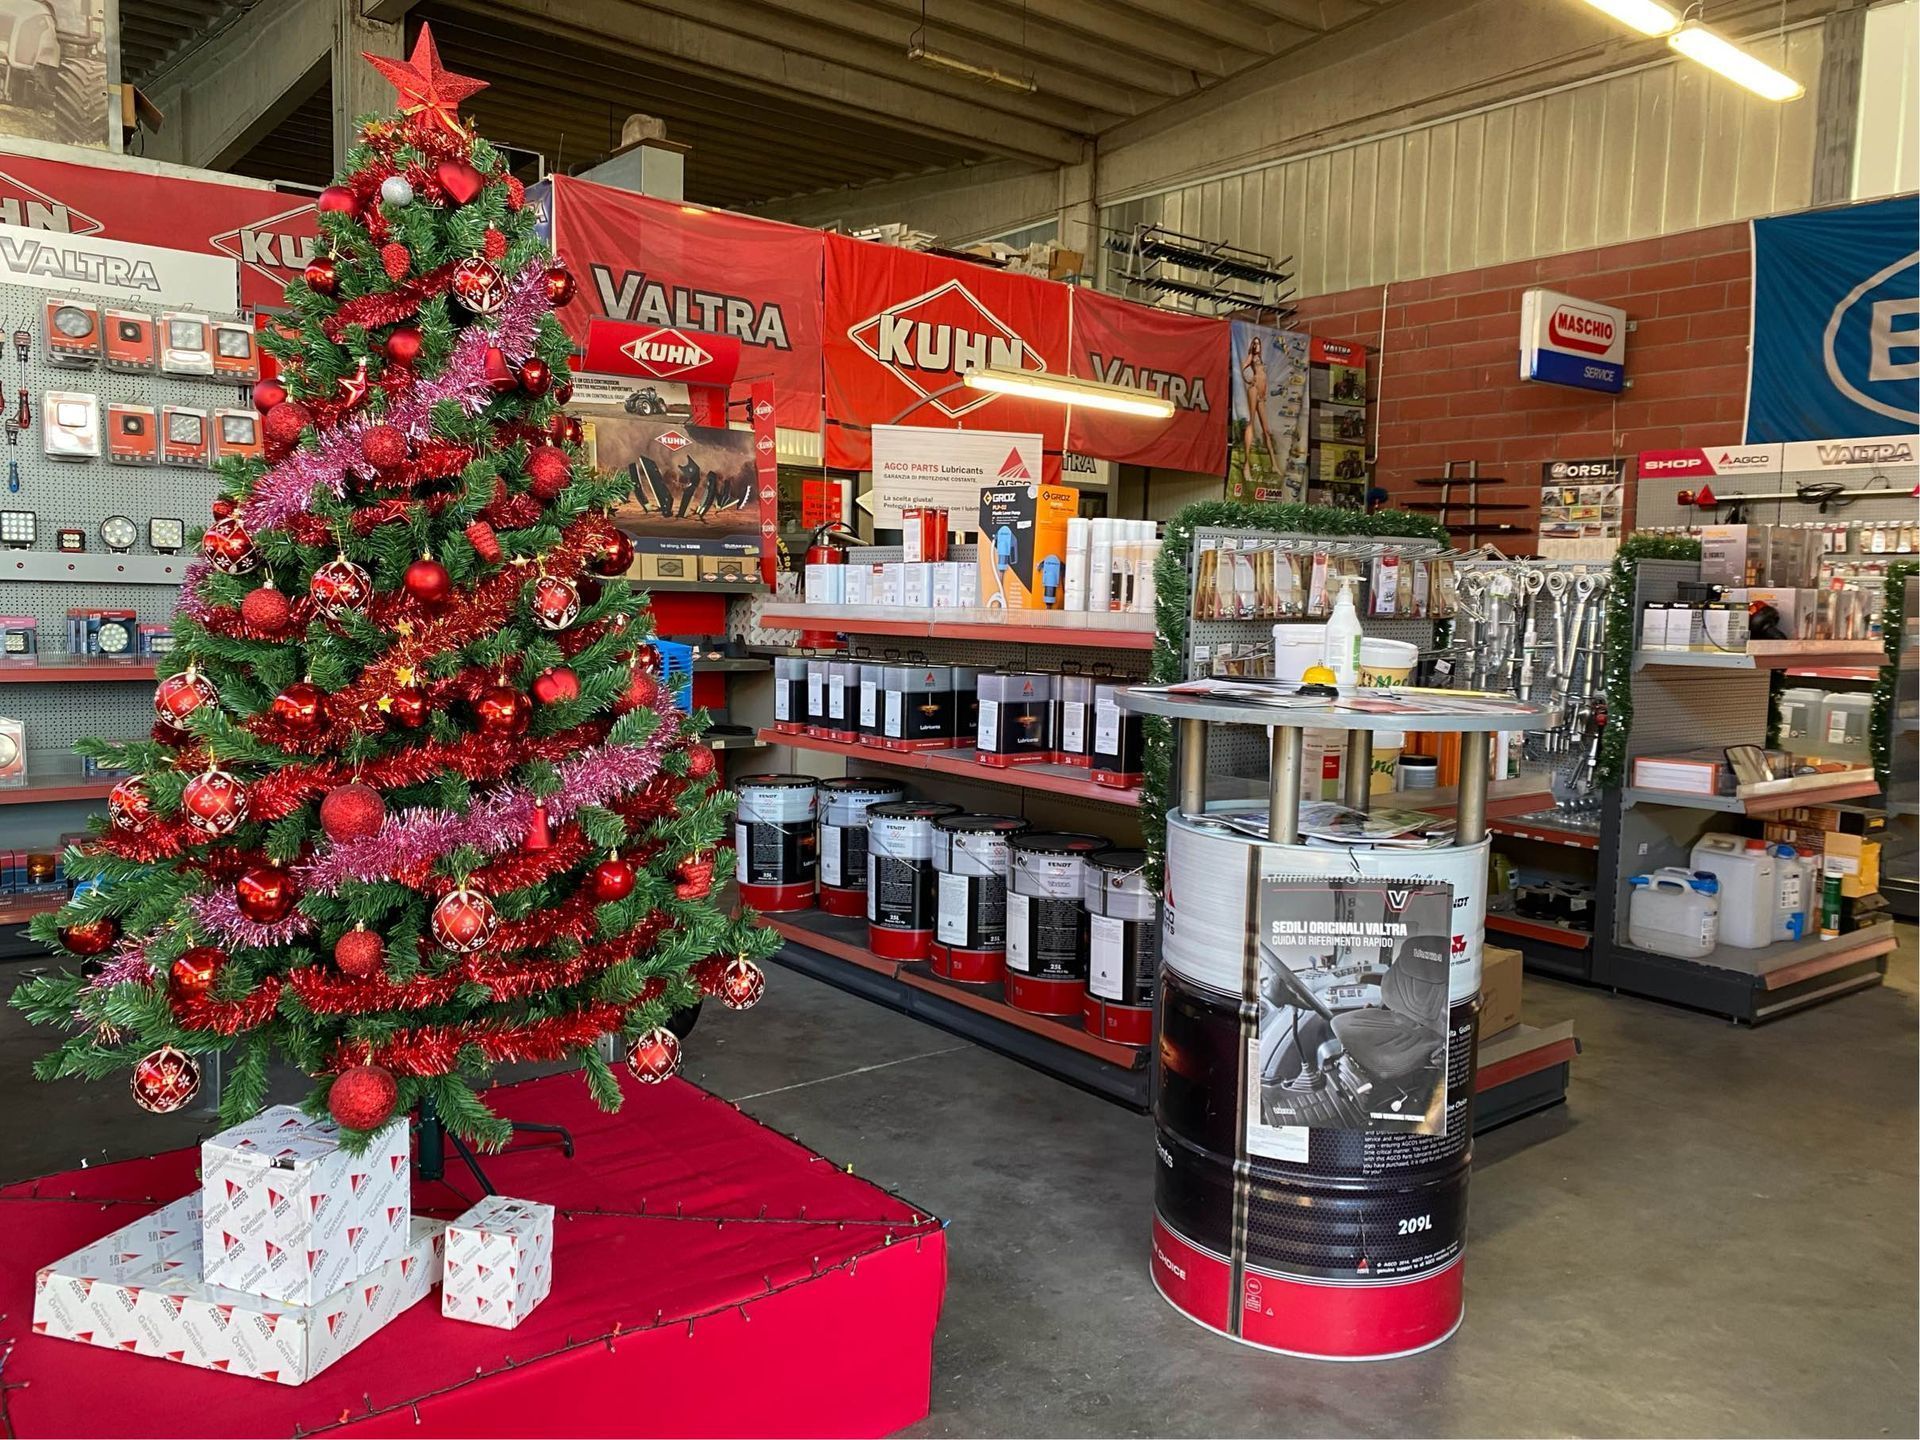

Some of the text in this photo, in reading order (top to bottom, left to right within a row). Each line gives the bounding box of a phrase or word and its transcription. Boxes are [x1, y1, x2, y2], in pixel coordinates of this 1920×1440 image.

[0, 236, 161, 292] VALTRA
[590, 263, 793, 351] VALTRA
[1557, 312, 1613, 340] MASCHIO
[633, 341, 701, 365] KUHN
[878, 314, 1023, 374] KUHN
[1090, 352, 1210, 412] VALTRA
[1583, 365, 1616, 382] SERVICE
[661, 436, 687, 446] KUHN
[1645, 458, 1701, 470] SHOP
[1733, 456, 1768, 464] AGCO
[1817, 443, 1913, 465] VALTRA
[884, 462, 984, 475] AGCO PARTS Lubricants
[1567, 464, 1607, 476] ORSI
[992, 492, 1016, 502] GROZ
[1050, 494, 1070, 502] GROZ
[1272, 920, 1408, 936] SEDILI ORIGINALI VALTRA
[1272, 935, 1394, 948] GUIDA DI RIFERIMENTO RAPIDO
[232, 1190, 247, 1207] AGCO
[274, 1200, 288, 1215] AGCO
[204, 1204, 229, 1230] Original
[240, 1208, 267, 1235] Genuine
[1398, 1214, 1432, 1235] 209L
[288, 1222, 312, 1248] Original
[228, 1242, 244, 1258] AGCO
[270, 1252, 286, 1268] AGCO
[1158, 1250, 1186, 1281] CHOICE
[71, 1280, 88, 1301] AGCO
[118, 1289, 134, 1311] AGCO
[48, 1297, 74, 1332] Original
[163, 1296, 178, 1319] AGCO
[90, 1302, 116, 1338] Genuine
[210, 1308, 226, 1330] AGCO
[256, 1316, 272, 1338] AGCO
[182, 1320, 207, 1358] Genuine
[232, 1335, 258, 1372] Original
